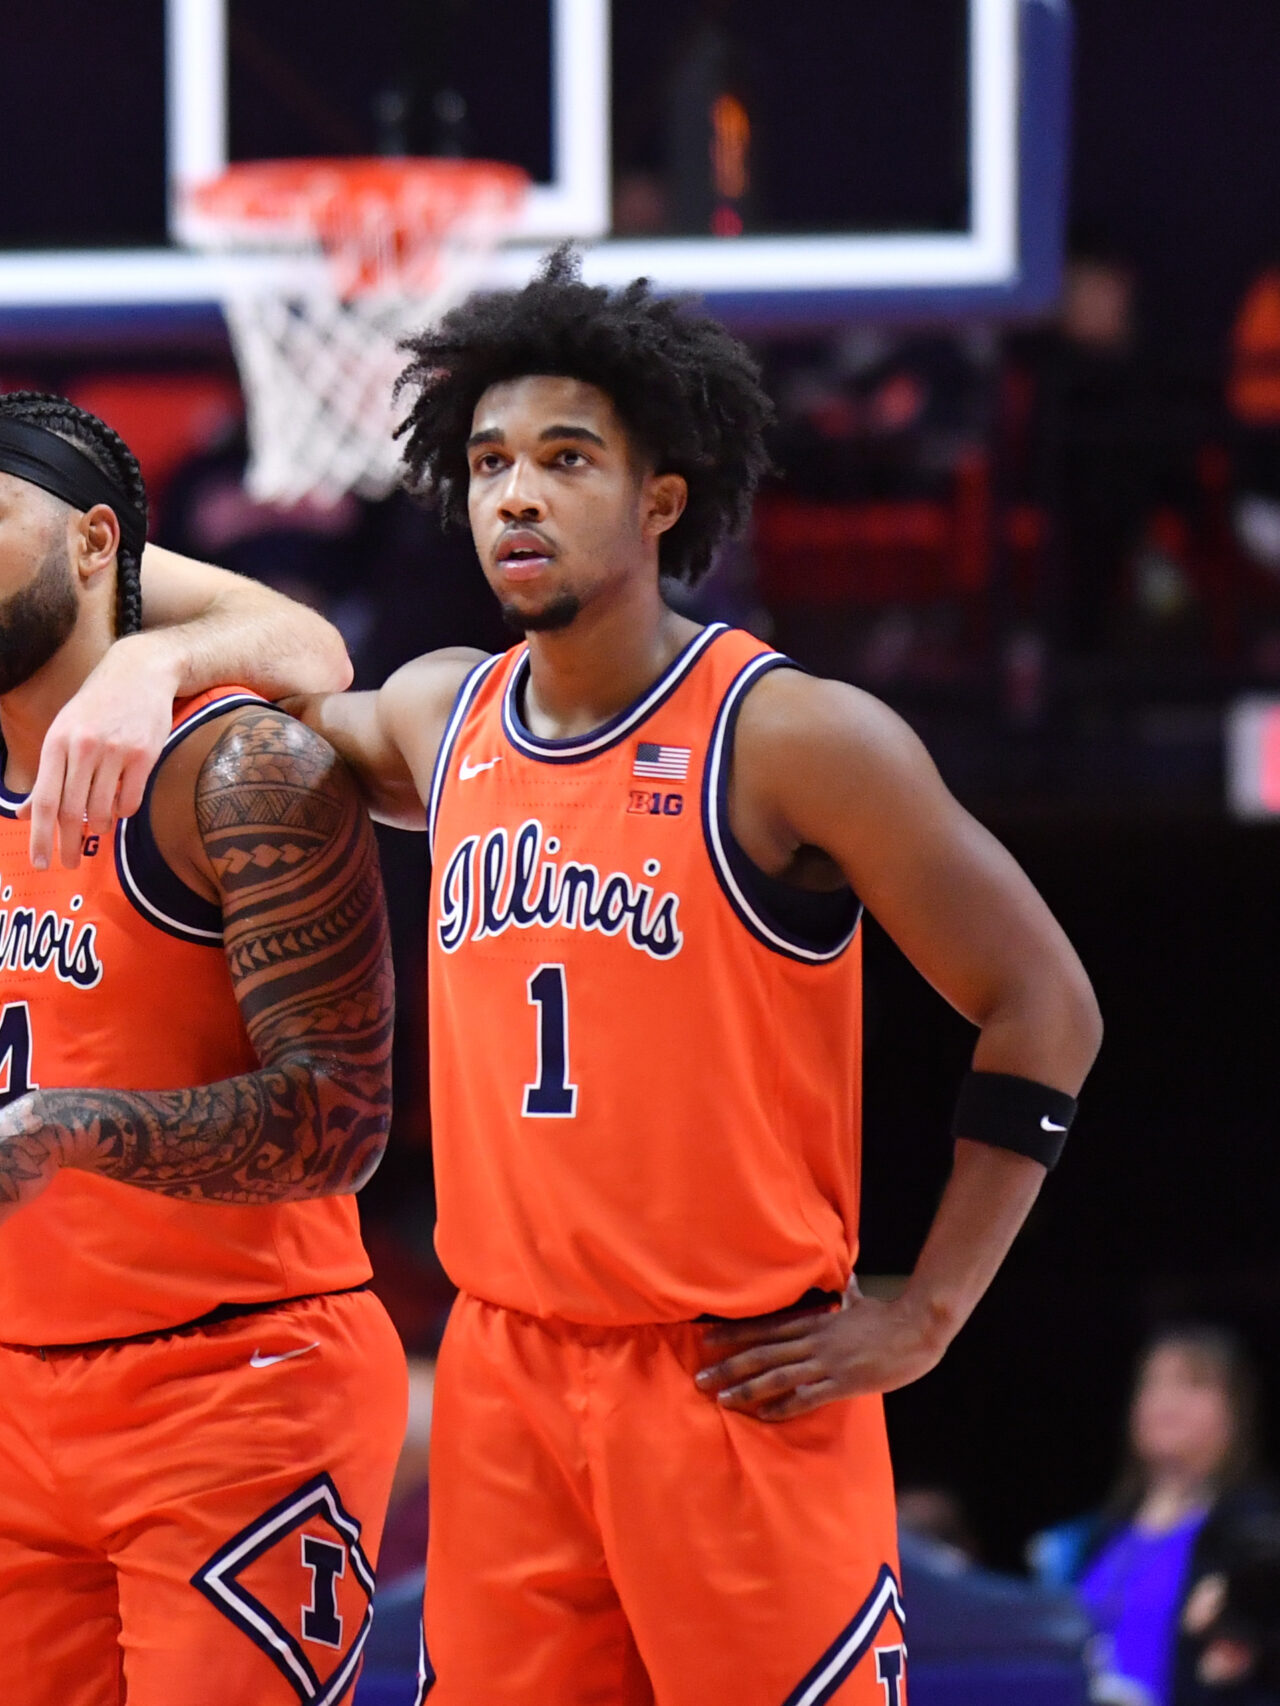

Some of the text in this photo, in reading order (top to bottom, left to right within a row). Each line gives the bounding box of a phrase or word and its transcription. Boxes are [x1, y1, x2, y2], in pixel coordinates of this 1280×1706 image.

[437, 818, 684, 961] Illinois
[521, 963, 578, 1118] 1
[301, 1533, 346, 1650] I
